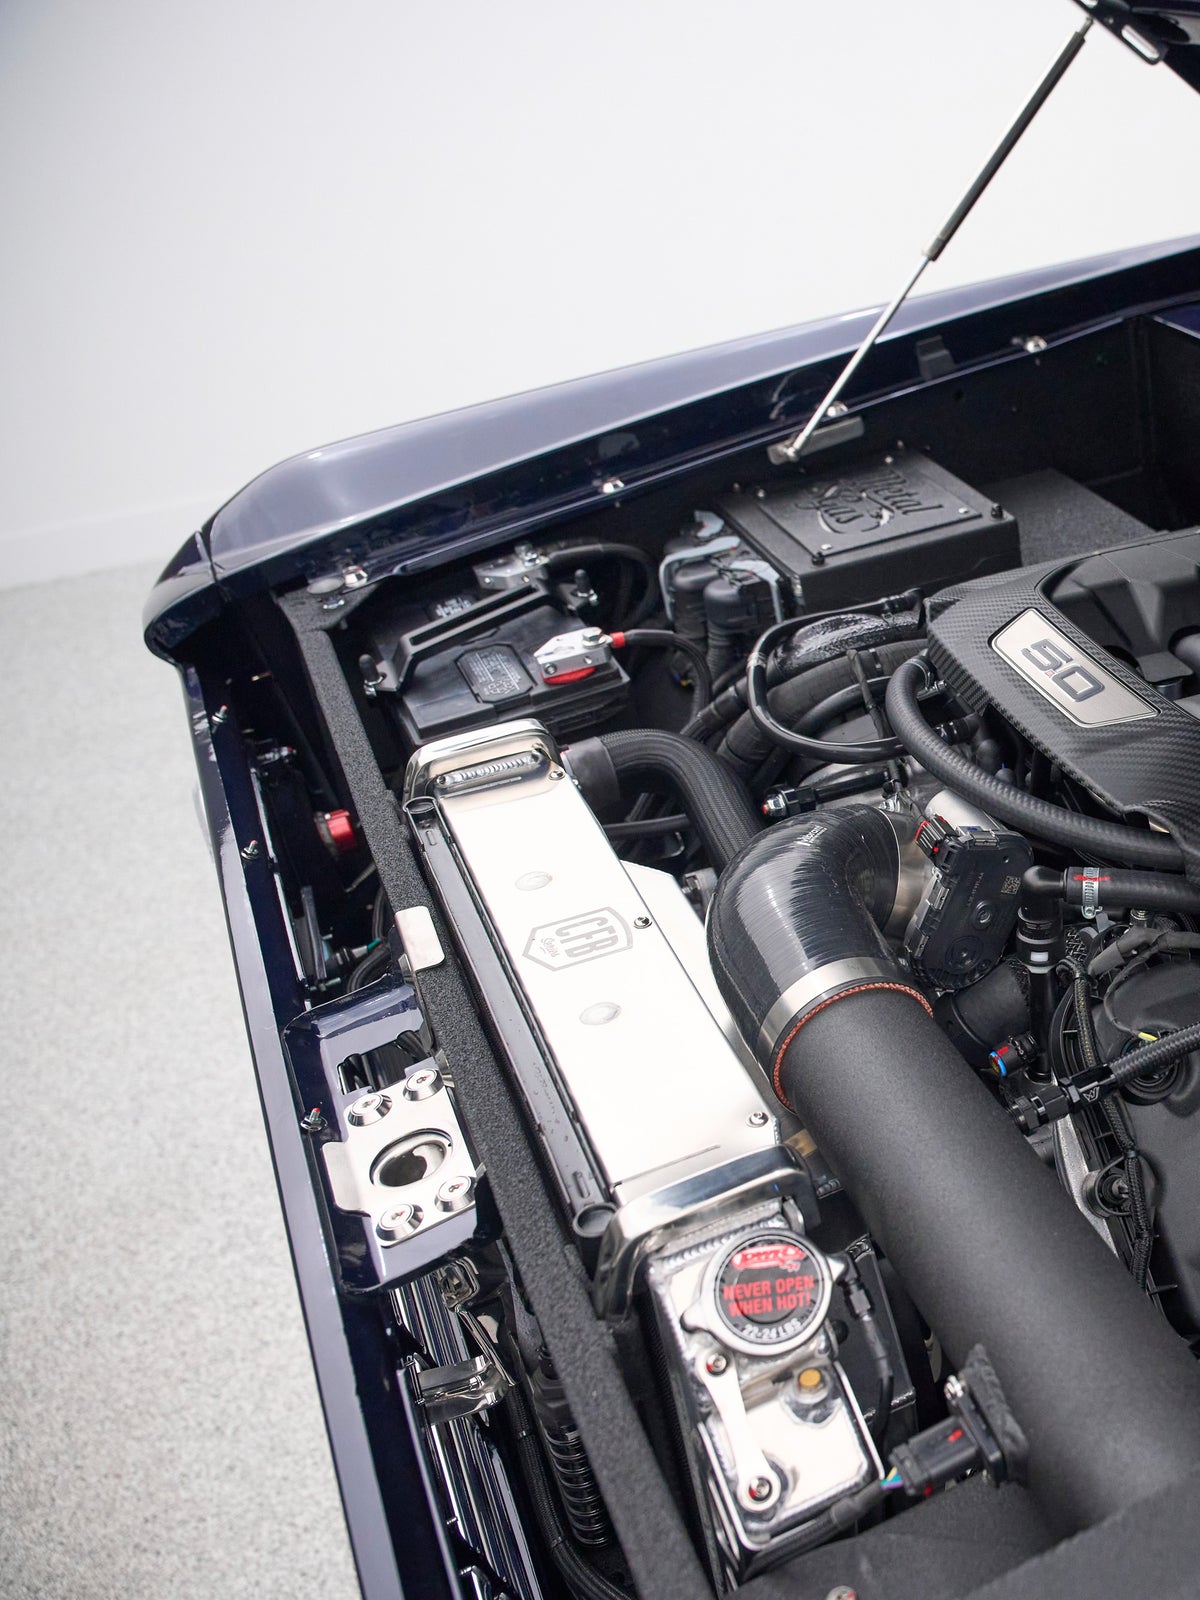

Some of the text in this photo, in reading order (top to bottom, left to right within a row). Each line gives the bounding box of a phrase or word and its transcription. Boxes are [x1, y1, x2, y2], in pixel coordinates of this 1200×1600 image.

[1021, 638, 1105, 701] 5.0
[555, 914, 622, 959] CFB
[724, 1275, 815, 1300] NEVER OPEN
[729, 1293, 810, 1317] WHEN HOT!
[778, 1318, 801, 1337] LBS
